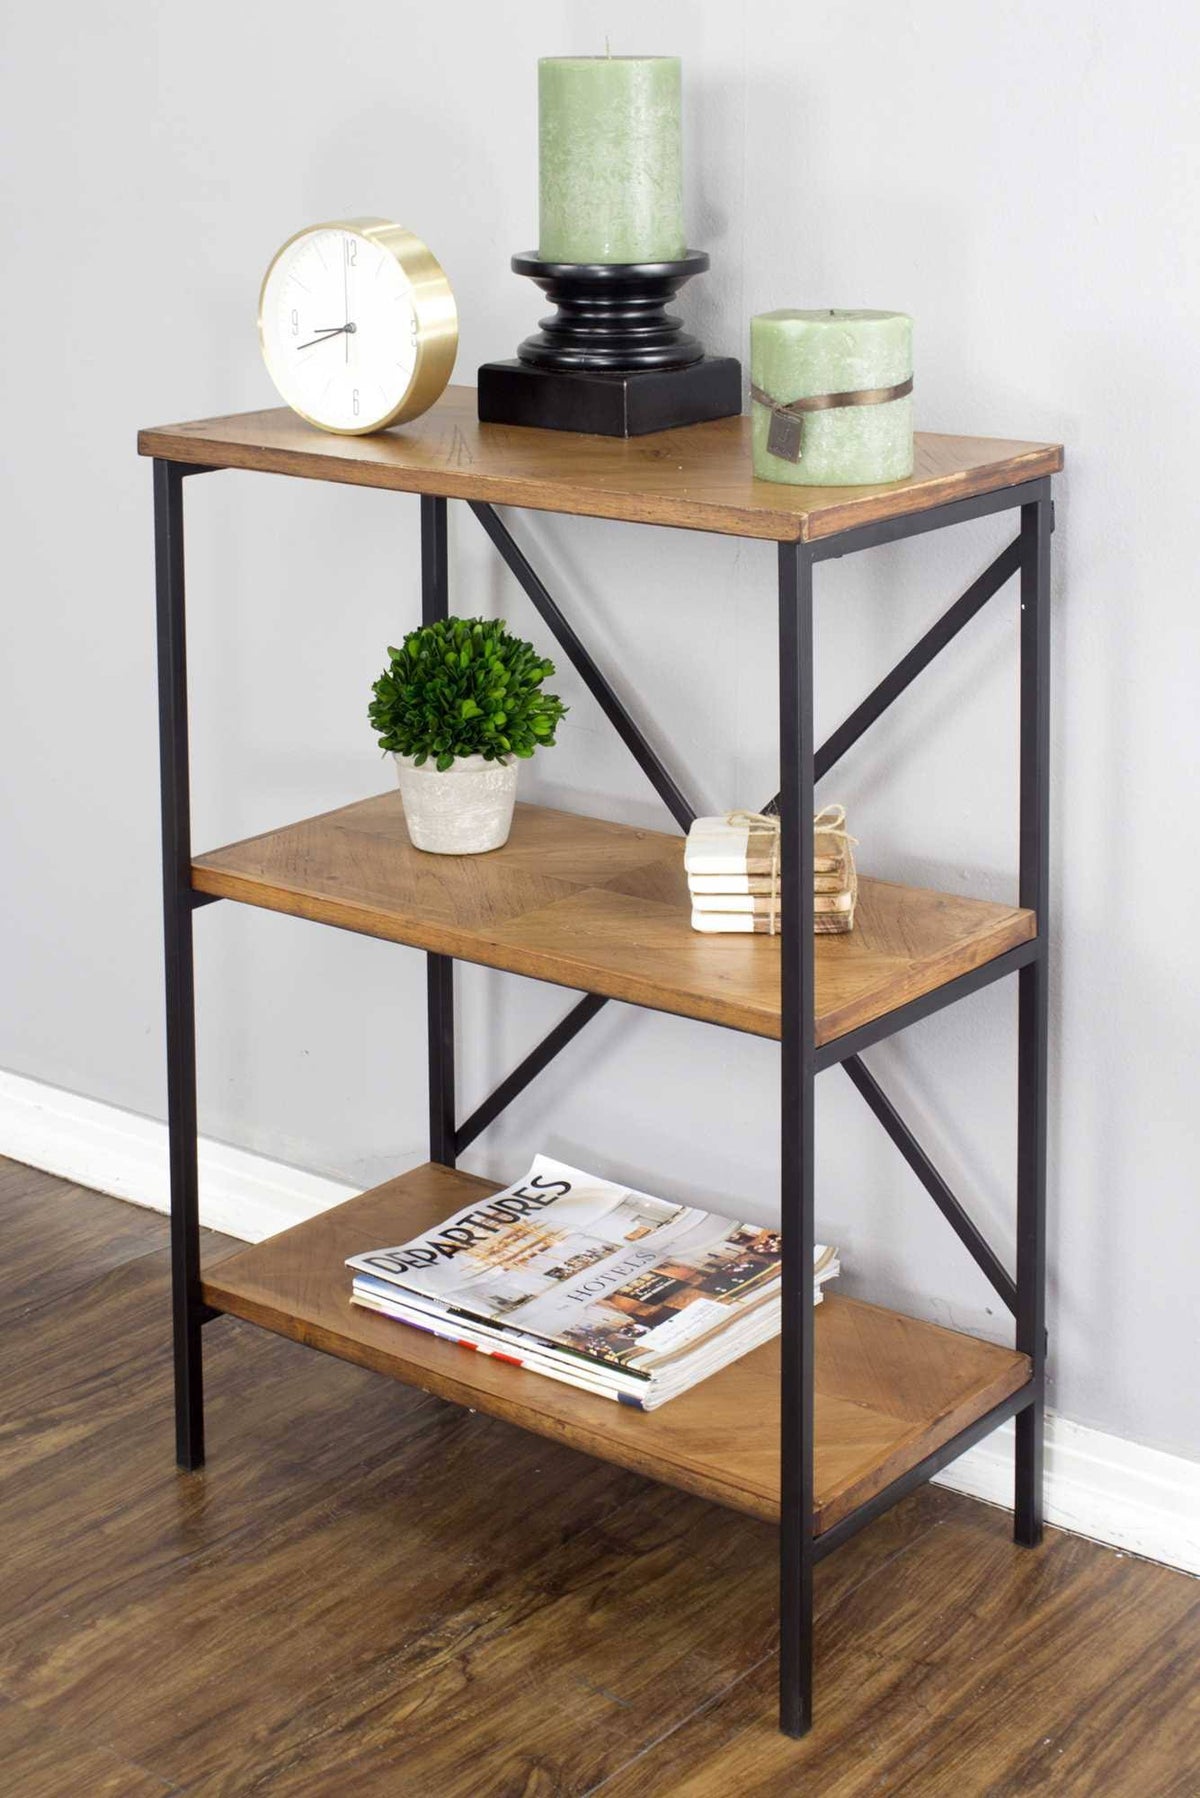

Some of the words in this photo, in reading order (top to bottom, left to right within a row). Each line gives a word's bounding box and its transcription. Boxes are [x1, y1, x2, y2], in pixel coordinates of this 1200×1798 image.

[346, 239, 358, 267] 12
[353, 388, 360, 416] 6
[362, 1175, 572, 1275] DEPARTURES
[567, 1251, 657, 1302] HOTELS
